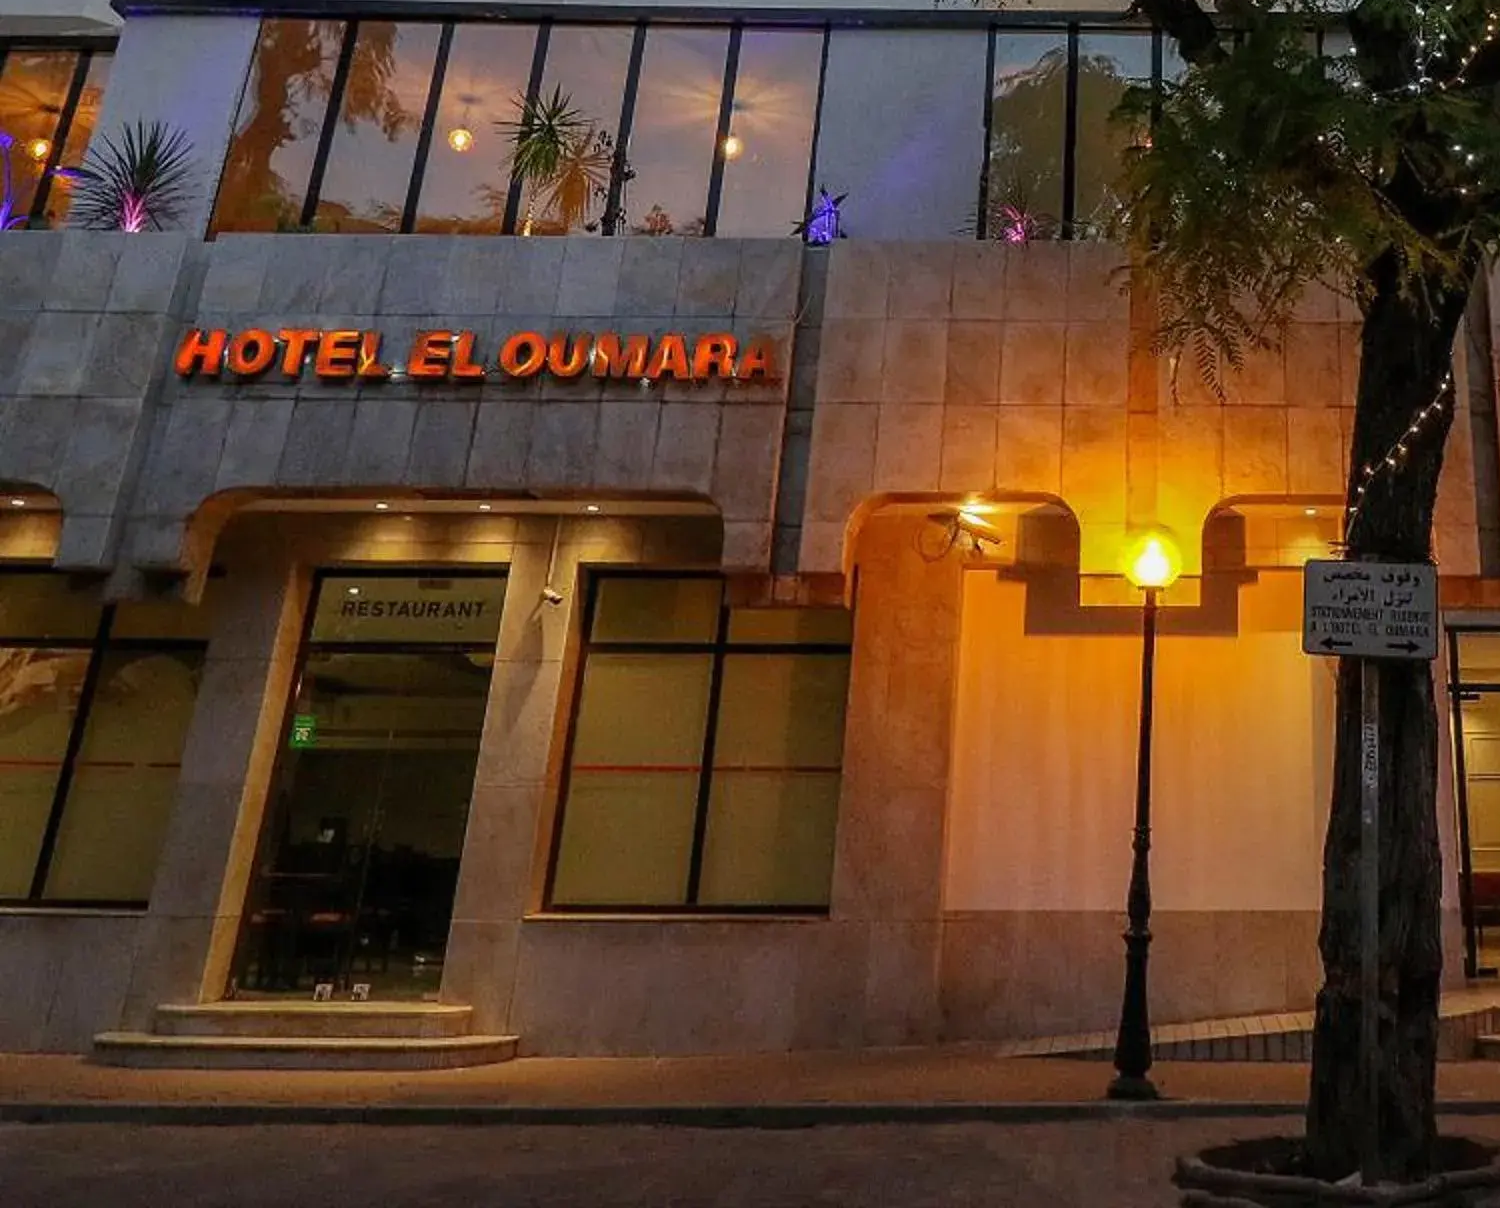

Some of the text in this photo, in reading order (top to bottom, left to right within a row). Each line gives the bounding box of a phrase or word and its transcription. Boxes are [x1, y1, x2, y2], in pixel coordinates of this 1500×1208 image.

[173, 327, 779, 380] HOTEL EL OUMARA
[341, 600, 486, 618] RESTAURANT
